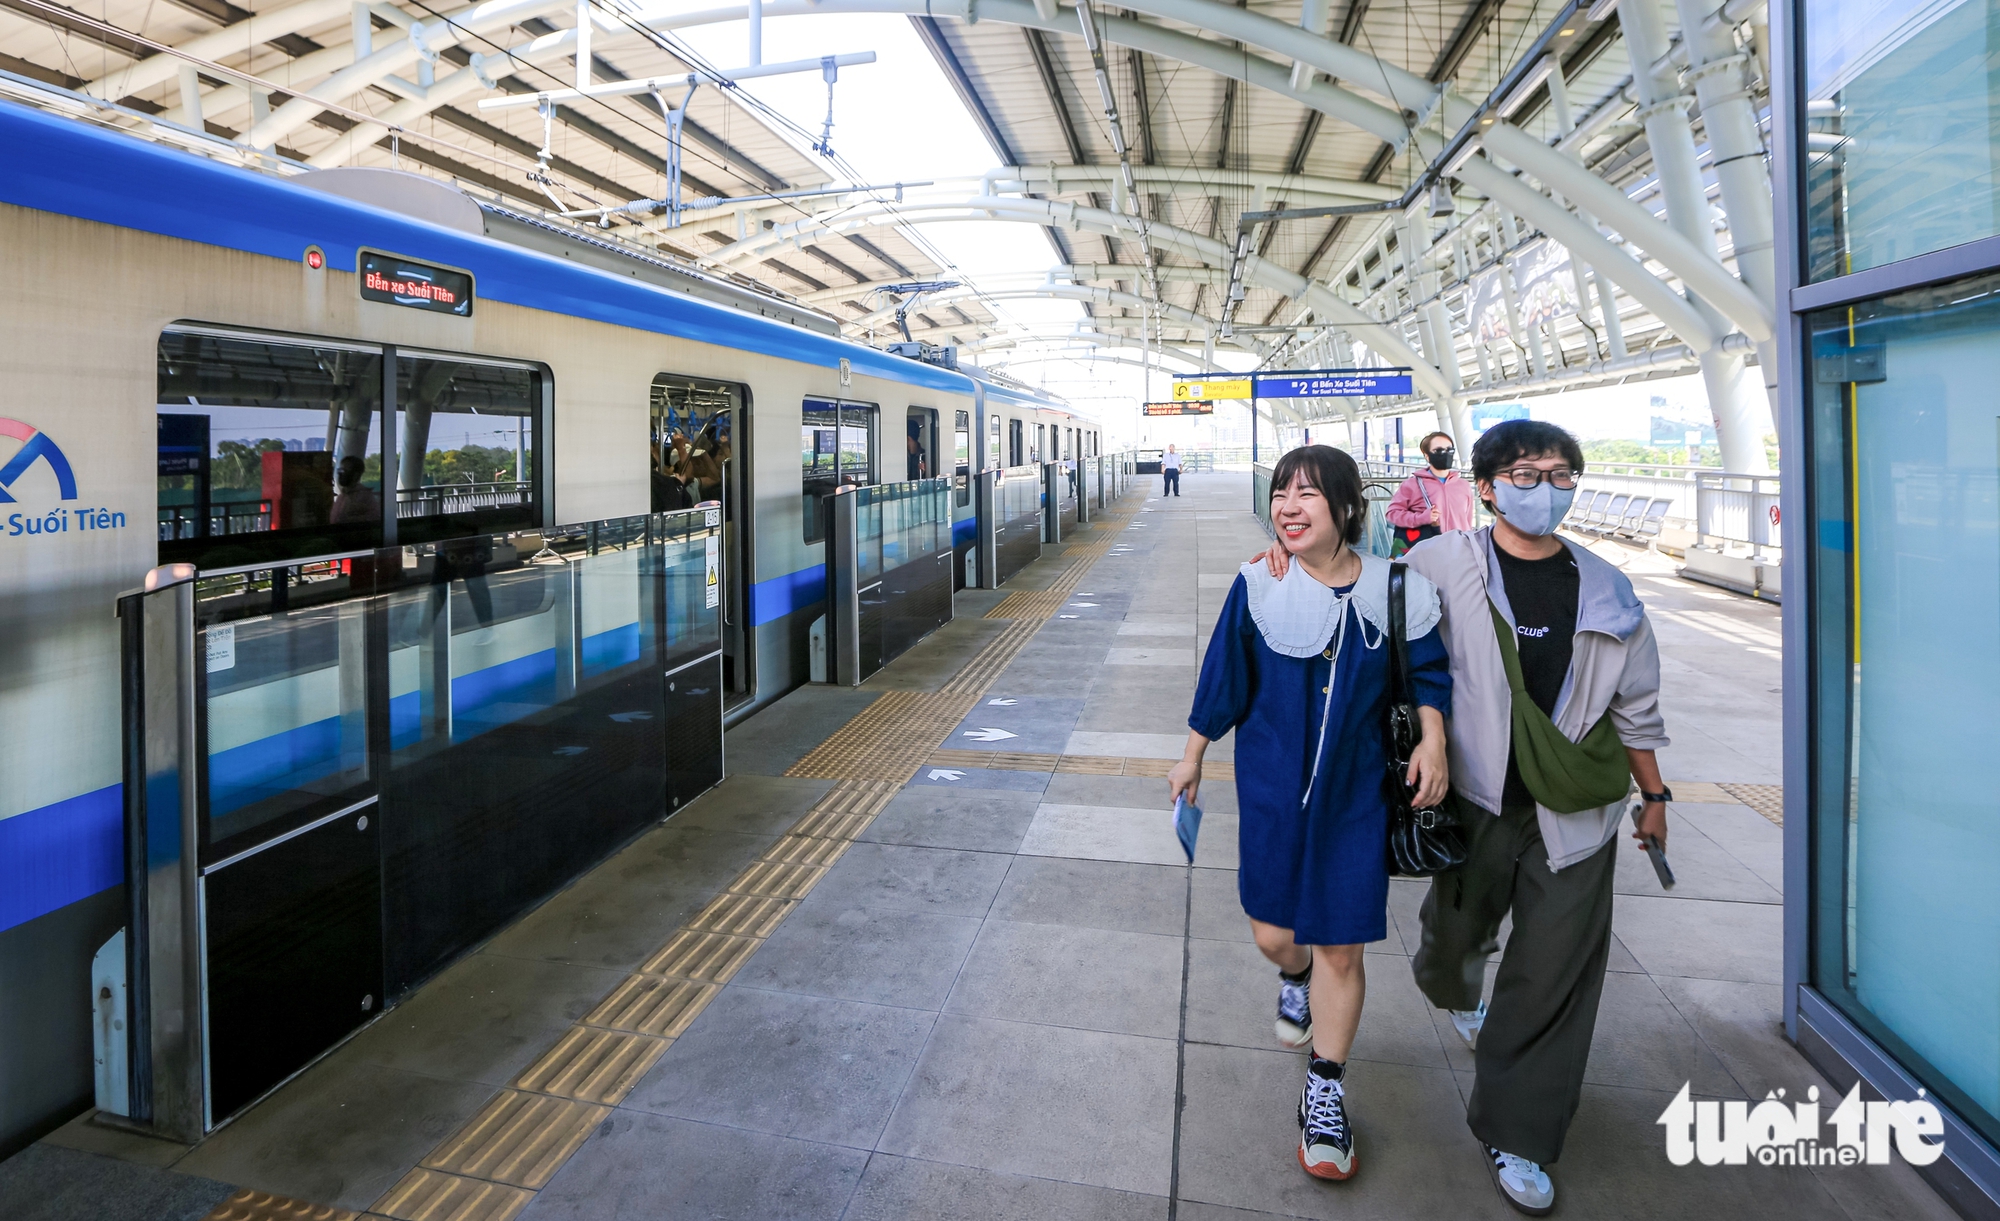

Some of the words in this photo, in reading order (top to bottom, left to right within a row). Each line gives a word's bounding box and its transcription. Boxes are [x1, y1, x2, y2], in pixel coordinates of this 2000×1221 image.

[390, 280, 405, 295] xe
[431, 286, 455, 303] Tiên
[1204, 384, 1225, 392] Thang
[1226, 383, 1241, 391] máy
[1299, 381, 1308, 395] 2
[1334, 380, 1343, 388] Xe
[1361, 379, 1377, 387] Tiên
[74, 507, 126, 531] Tiên
